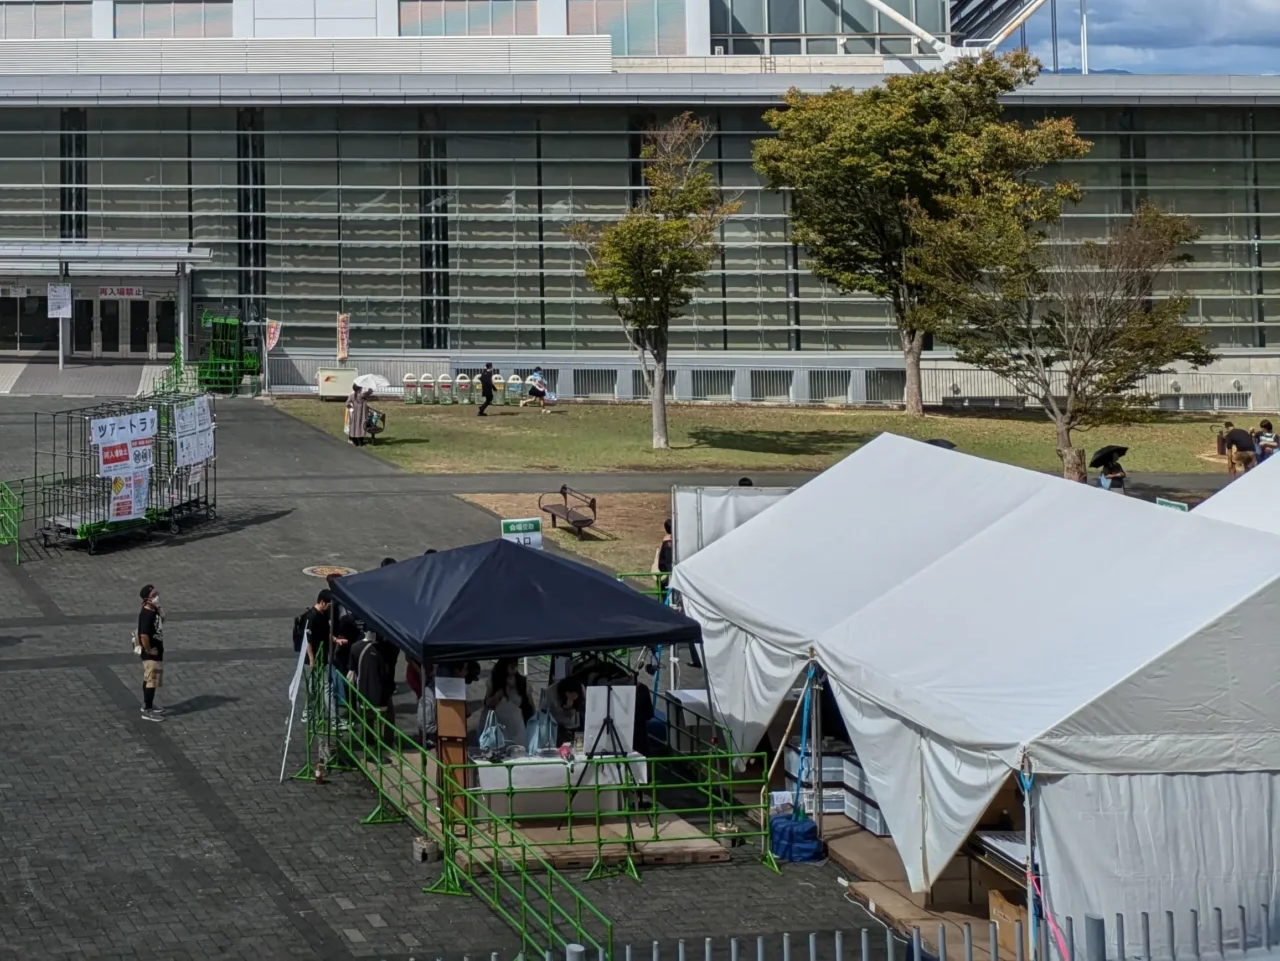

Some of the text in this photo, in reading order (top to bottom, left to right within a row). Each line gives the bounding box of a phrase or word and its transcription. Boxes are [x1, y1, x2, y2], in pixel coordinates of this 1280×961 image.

[99, 287, 143, 296] 再入場禁止
[515, 537, 532, 546] 入口
